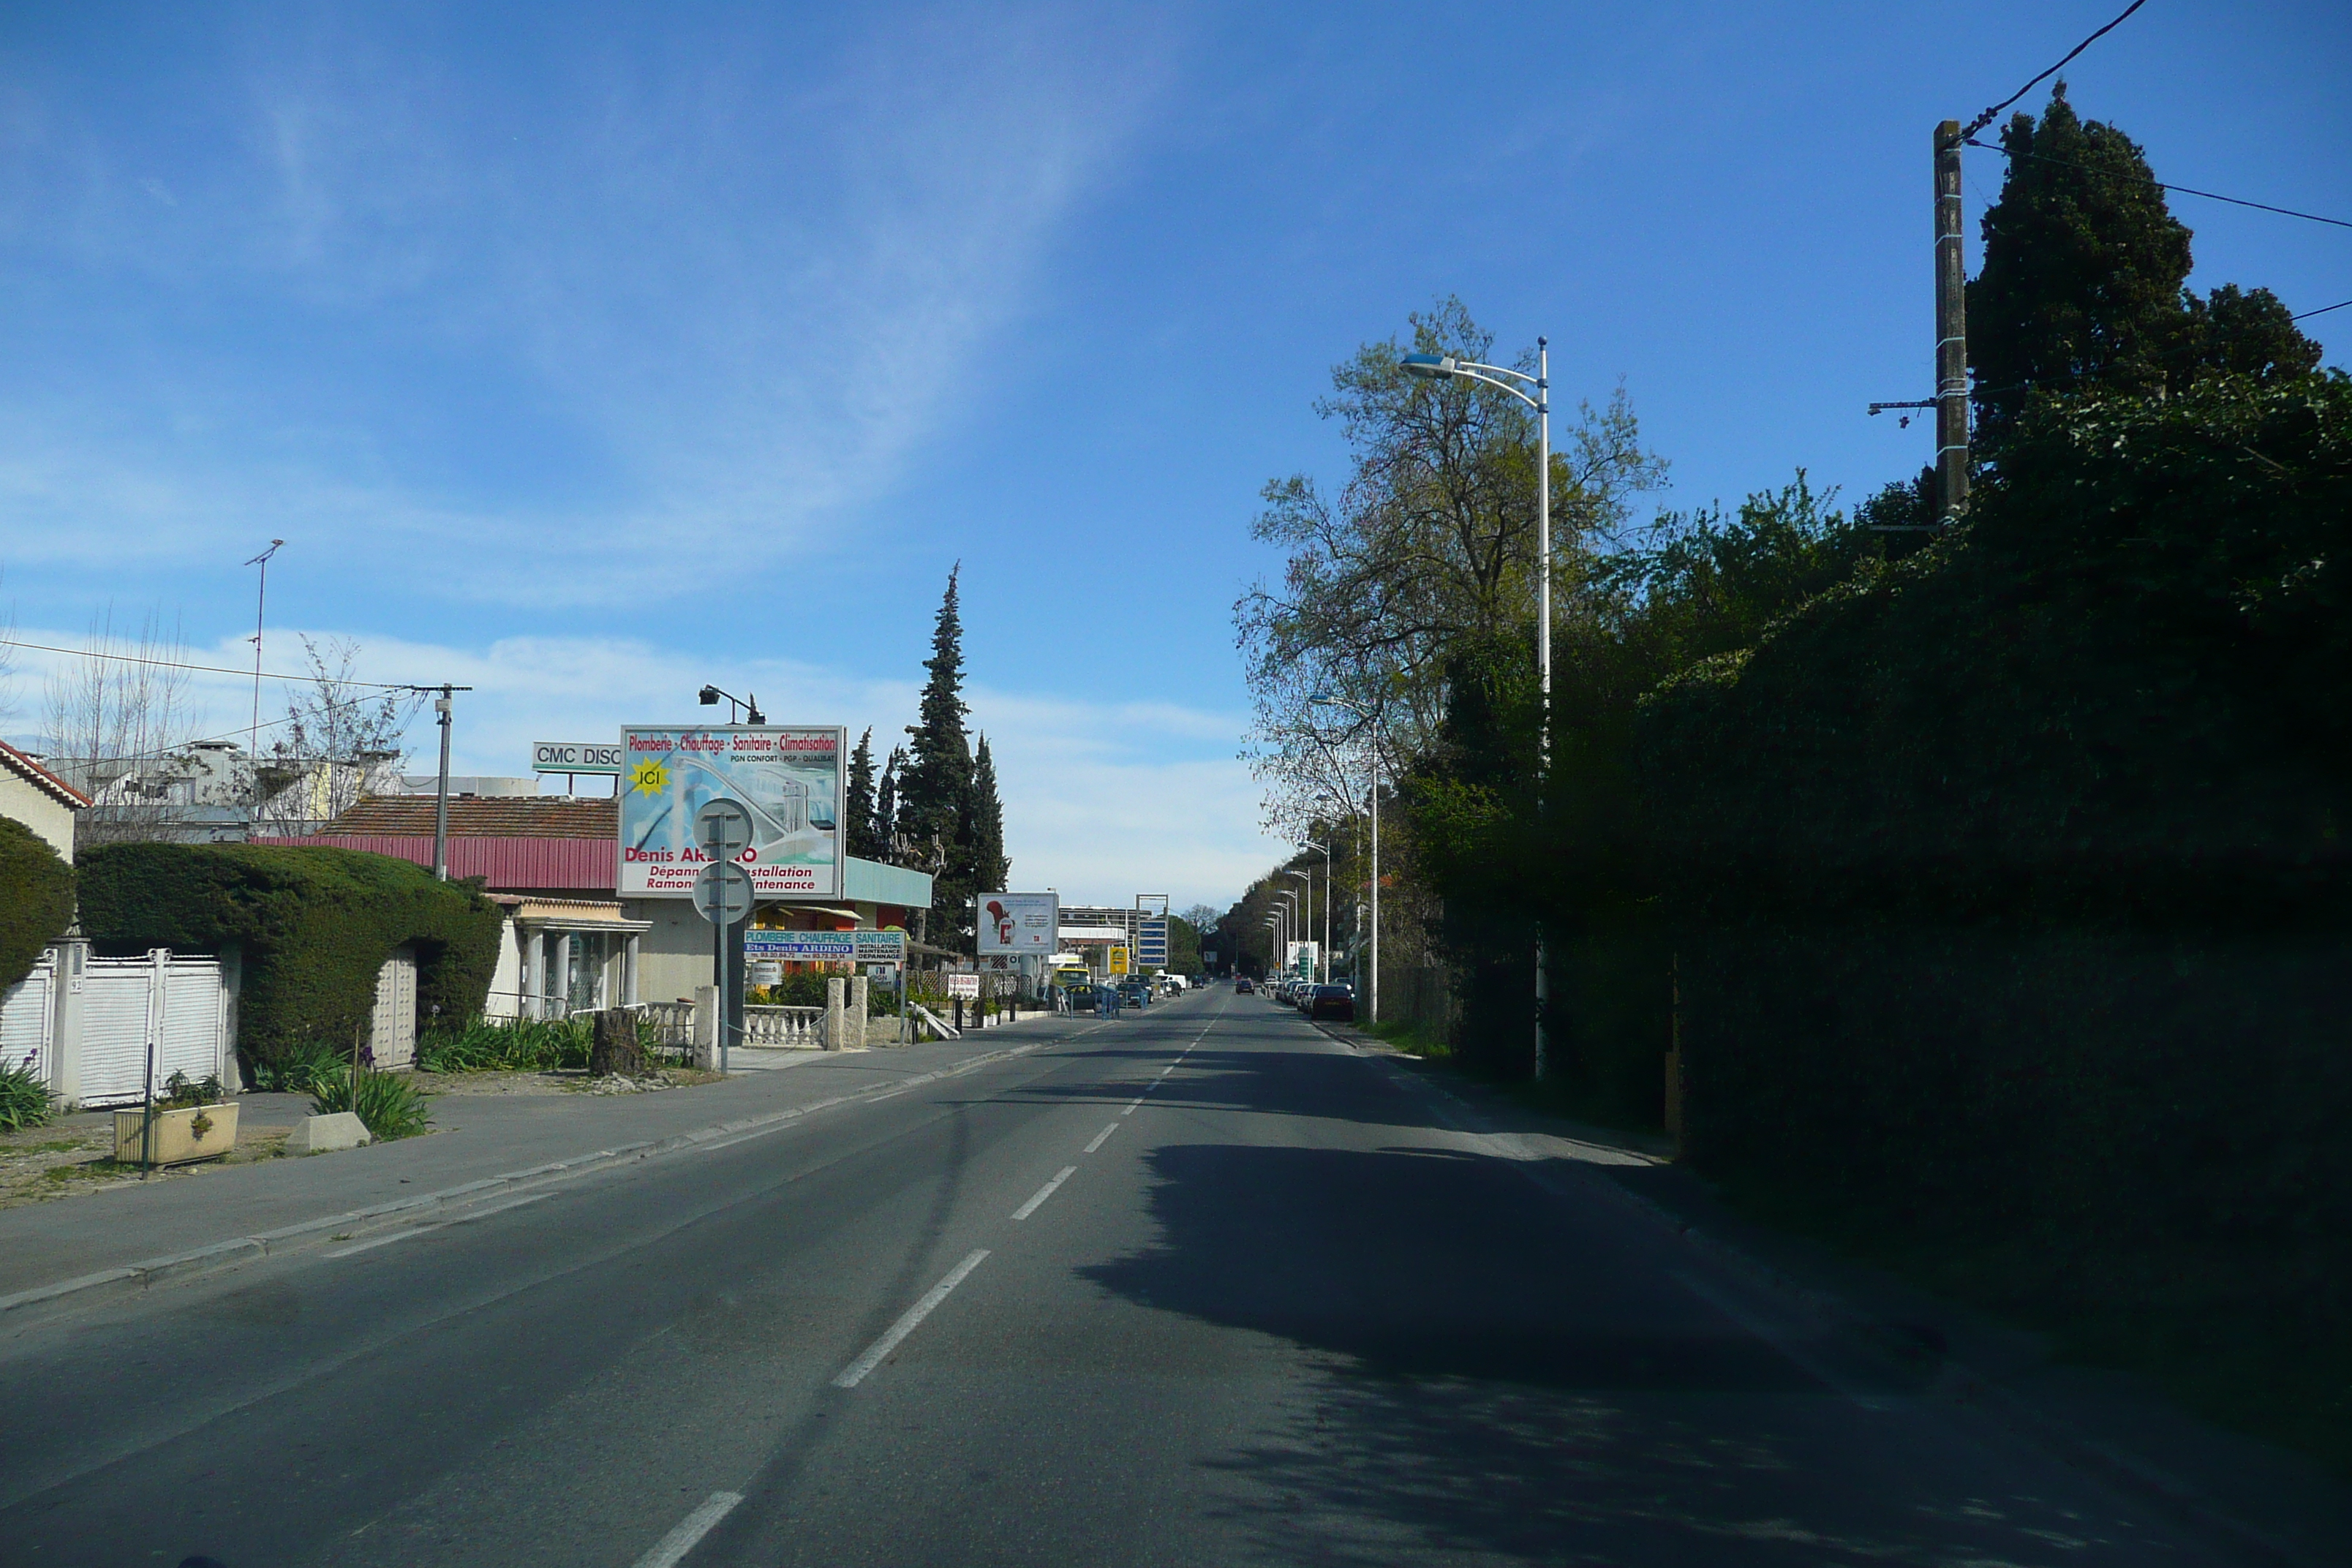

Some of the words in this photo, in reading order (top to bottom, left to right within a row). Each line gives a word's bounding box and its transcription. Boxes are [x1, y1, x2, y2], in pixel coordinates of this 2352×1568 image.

[629, 734, 672, 752] Plomberie
[679, 734, 725, 755] Chauffage
[732, 734, 772, 751] Sanitaire
[780, 734, 835, 751] Climatisation
[537, 747, 576, 763] CMC
[783, 755, 797, 763] PGP
[639, 771, 660, 785] ICI
[625, 846, 674, 862] Denis
[650, 865, 700, 879] Dépann
[746, 866, 813, 878] stallation
[746, 932, 795, 942] PLOMBERIE
[799, 933, 852, 943] CHAUFFAGE
[856, 933, 900, 943] SANITAIRE
[746, 943, 765, 951] Ets
[767, 944, 799, 952] Denis
[802, 945, 850, 953] ARDINO
[72, 981, 82, 990] 92
